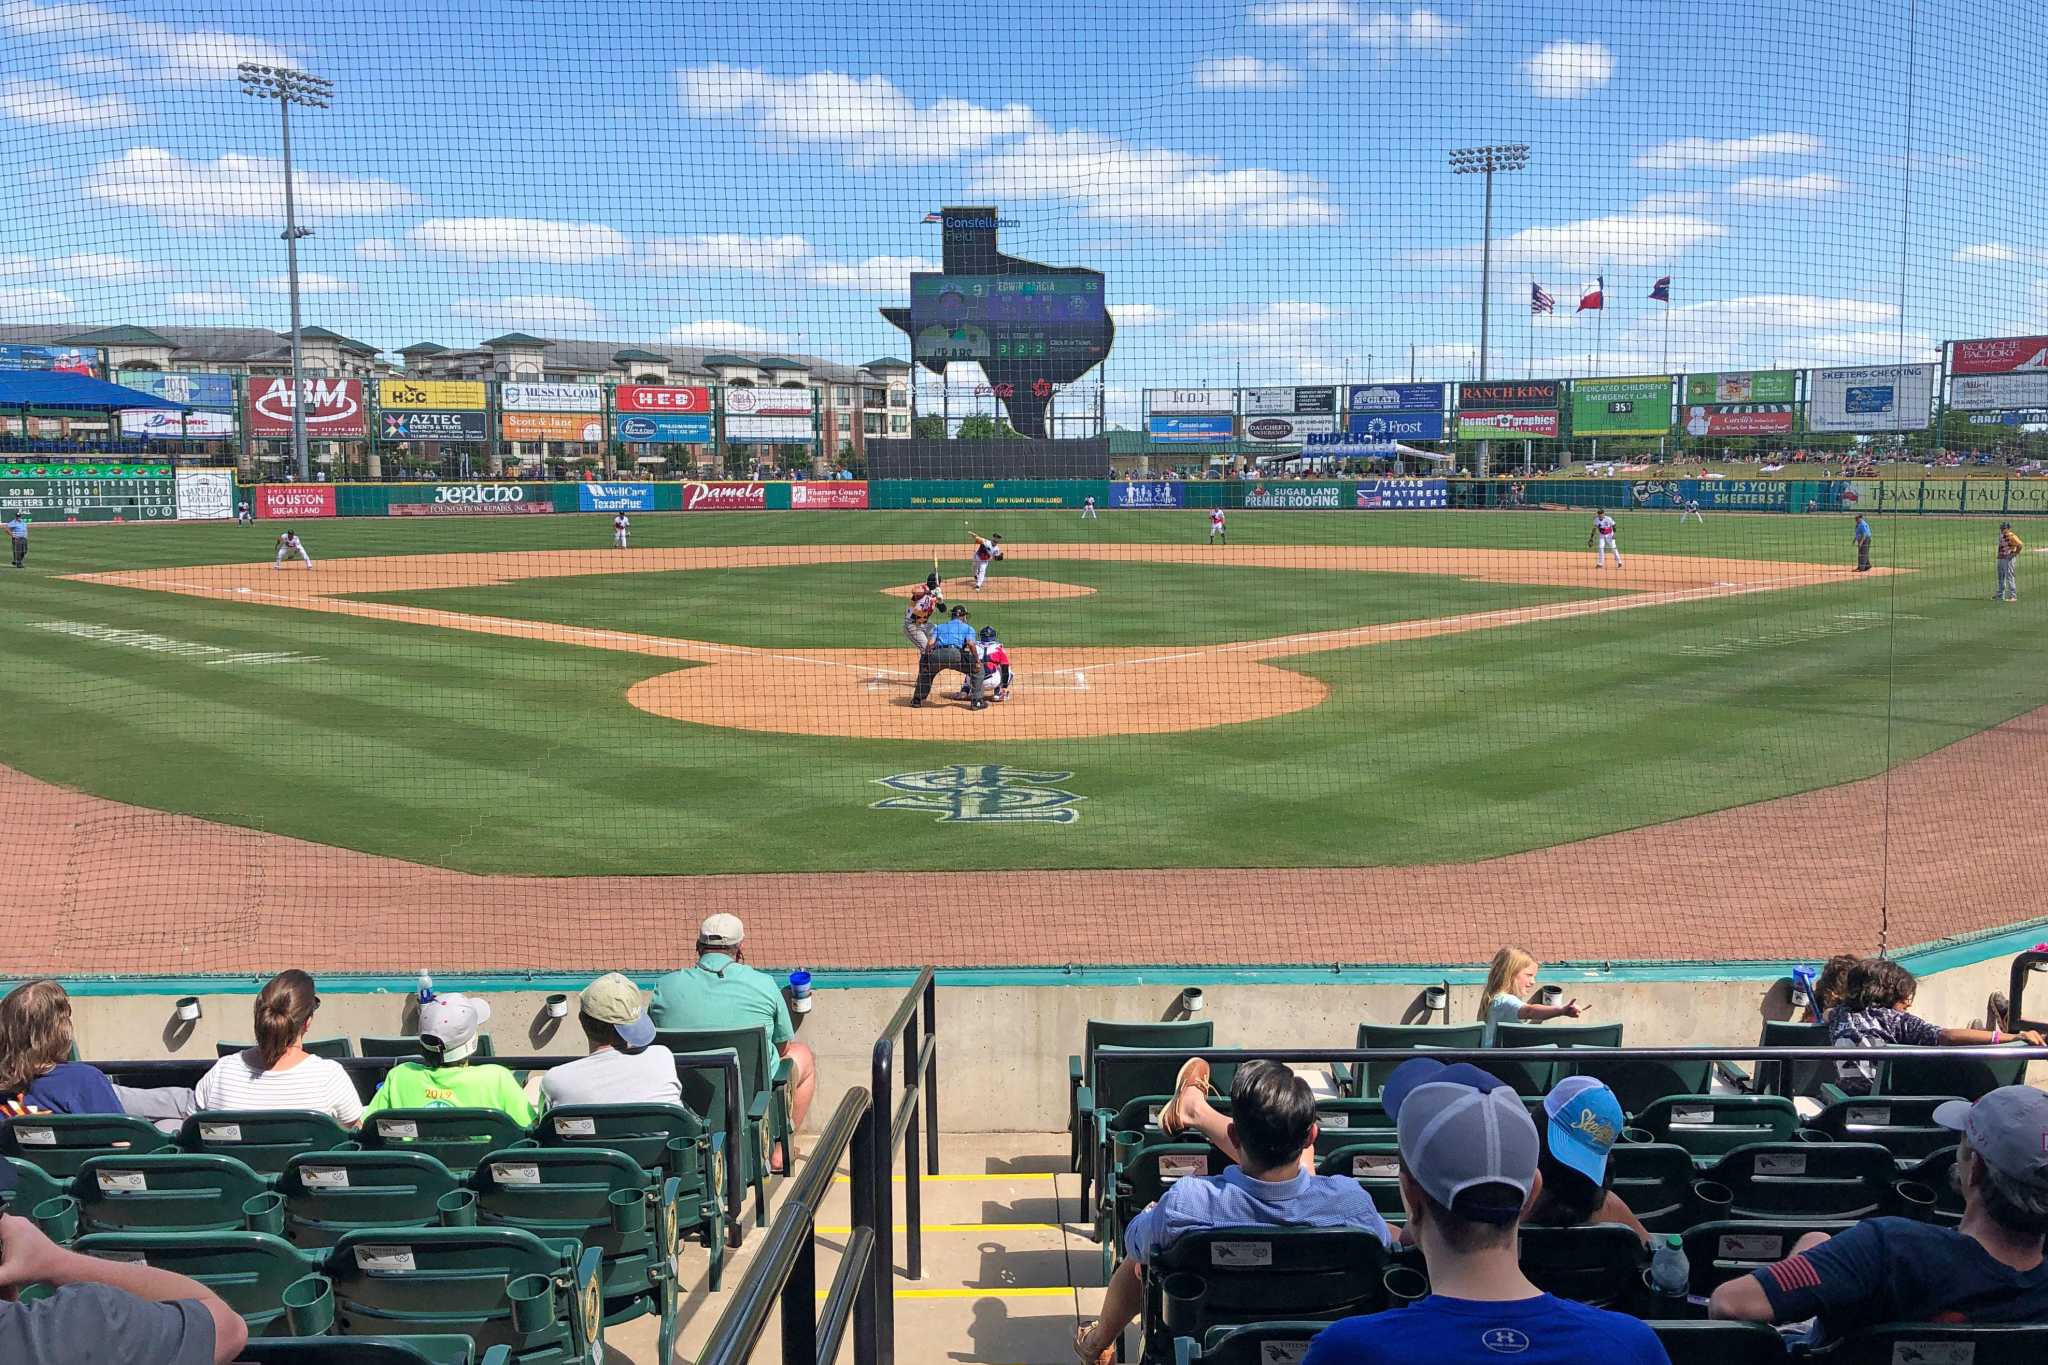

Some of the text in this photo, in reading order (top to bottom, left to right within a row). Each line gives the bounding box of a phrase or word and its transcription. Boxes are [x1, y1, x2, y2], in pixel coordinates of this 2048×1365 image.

[946, 216, 1020, 229] Constellation
[1000, 345, 1043, 353] 3 2 2
[1822, 368, 1922, 379] SKEETERS CHECKING
[1463, 386, 1553, 399] RANCH KING
[1576, 383, 1668, 393] DEDICATED CHILDREN'S
[392, 391, 427, 403] HCC
[1585, 392, 1657, 401] EMERGENCY CARE
[409, 415, 461, 424] AZTEC
[509, 416, 535, 425] Scott
[1970, 415, 2002, 424] GRASS
[1389, 421, 1422, 433] Frost
[1307, 433, 1341, 445] BUD
[1344, 432, 1393, 445] LIGHT
[1383, 480, 1424, 488] TEXAS
[1698, 482, 1725, 492] SELL
[1746, 481, 1787, 492] YOUR
[606, 485, 648, 496] WellCare
[683, 482, 765, 509] Pamela
[807, 488, 866, 497] Wharton County
[1274, 487, 1339, 496] SUGAR LAND
[1383, 489, 1447, 497] MATTRESS
[267, 495, 324, 505] HOUSTON
[592, 499, 641, 509] TexanPlus
[832, 495, 860, 505] College
[1245, 495, 1339, 507] PREMIER ROOFING
[1383, 499, 1447, 507] MAKERS
[1714, 494, 1773, 504] SKEETERS
[430, 504, 483, 513] FOUNDATION
